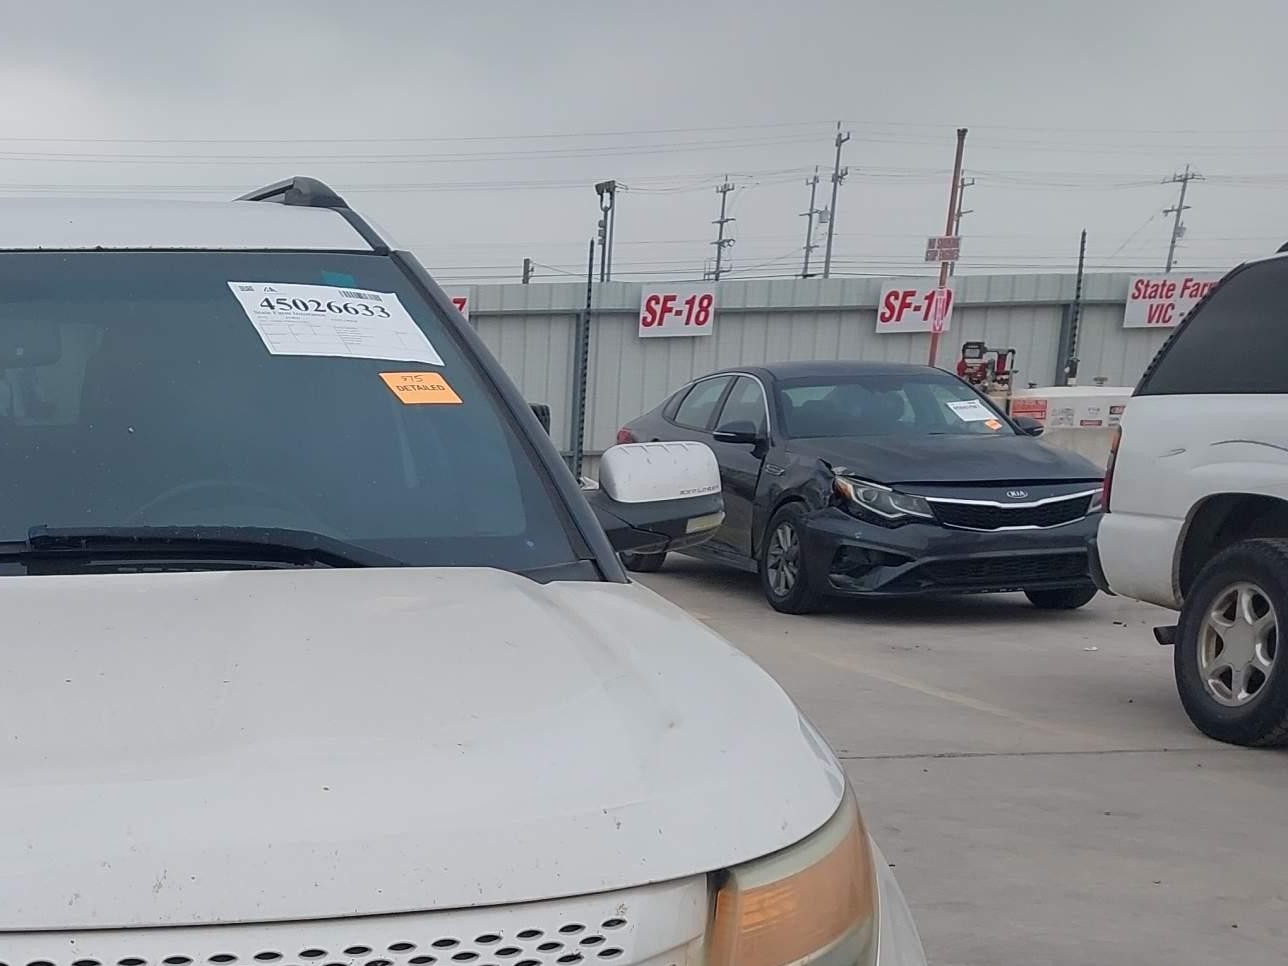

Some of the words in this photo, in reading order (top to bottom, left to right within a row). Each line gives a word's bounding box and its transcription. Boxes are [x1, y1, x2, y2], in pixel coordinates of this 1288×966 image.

[1132, 279, 1176, 299] State
[1179, 277, 1219, 298] Far
[260, 297, 391, 319] 45026633
[642, 294, 713, 327] SF-18
[1147, 302, 1175, 324] VIC
[396, 384, 446, 392] DETAILED
